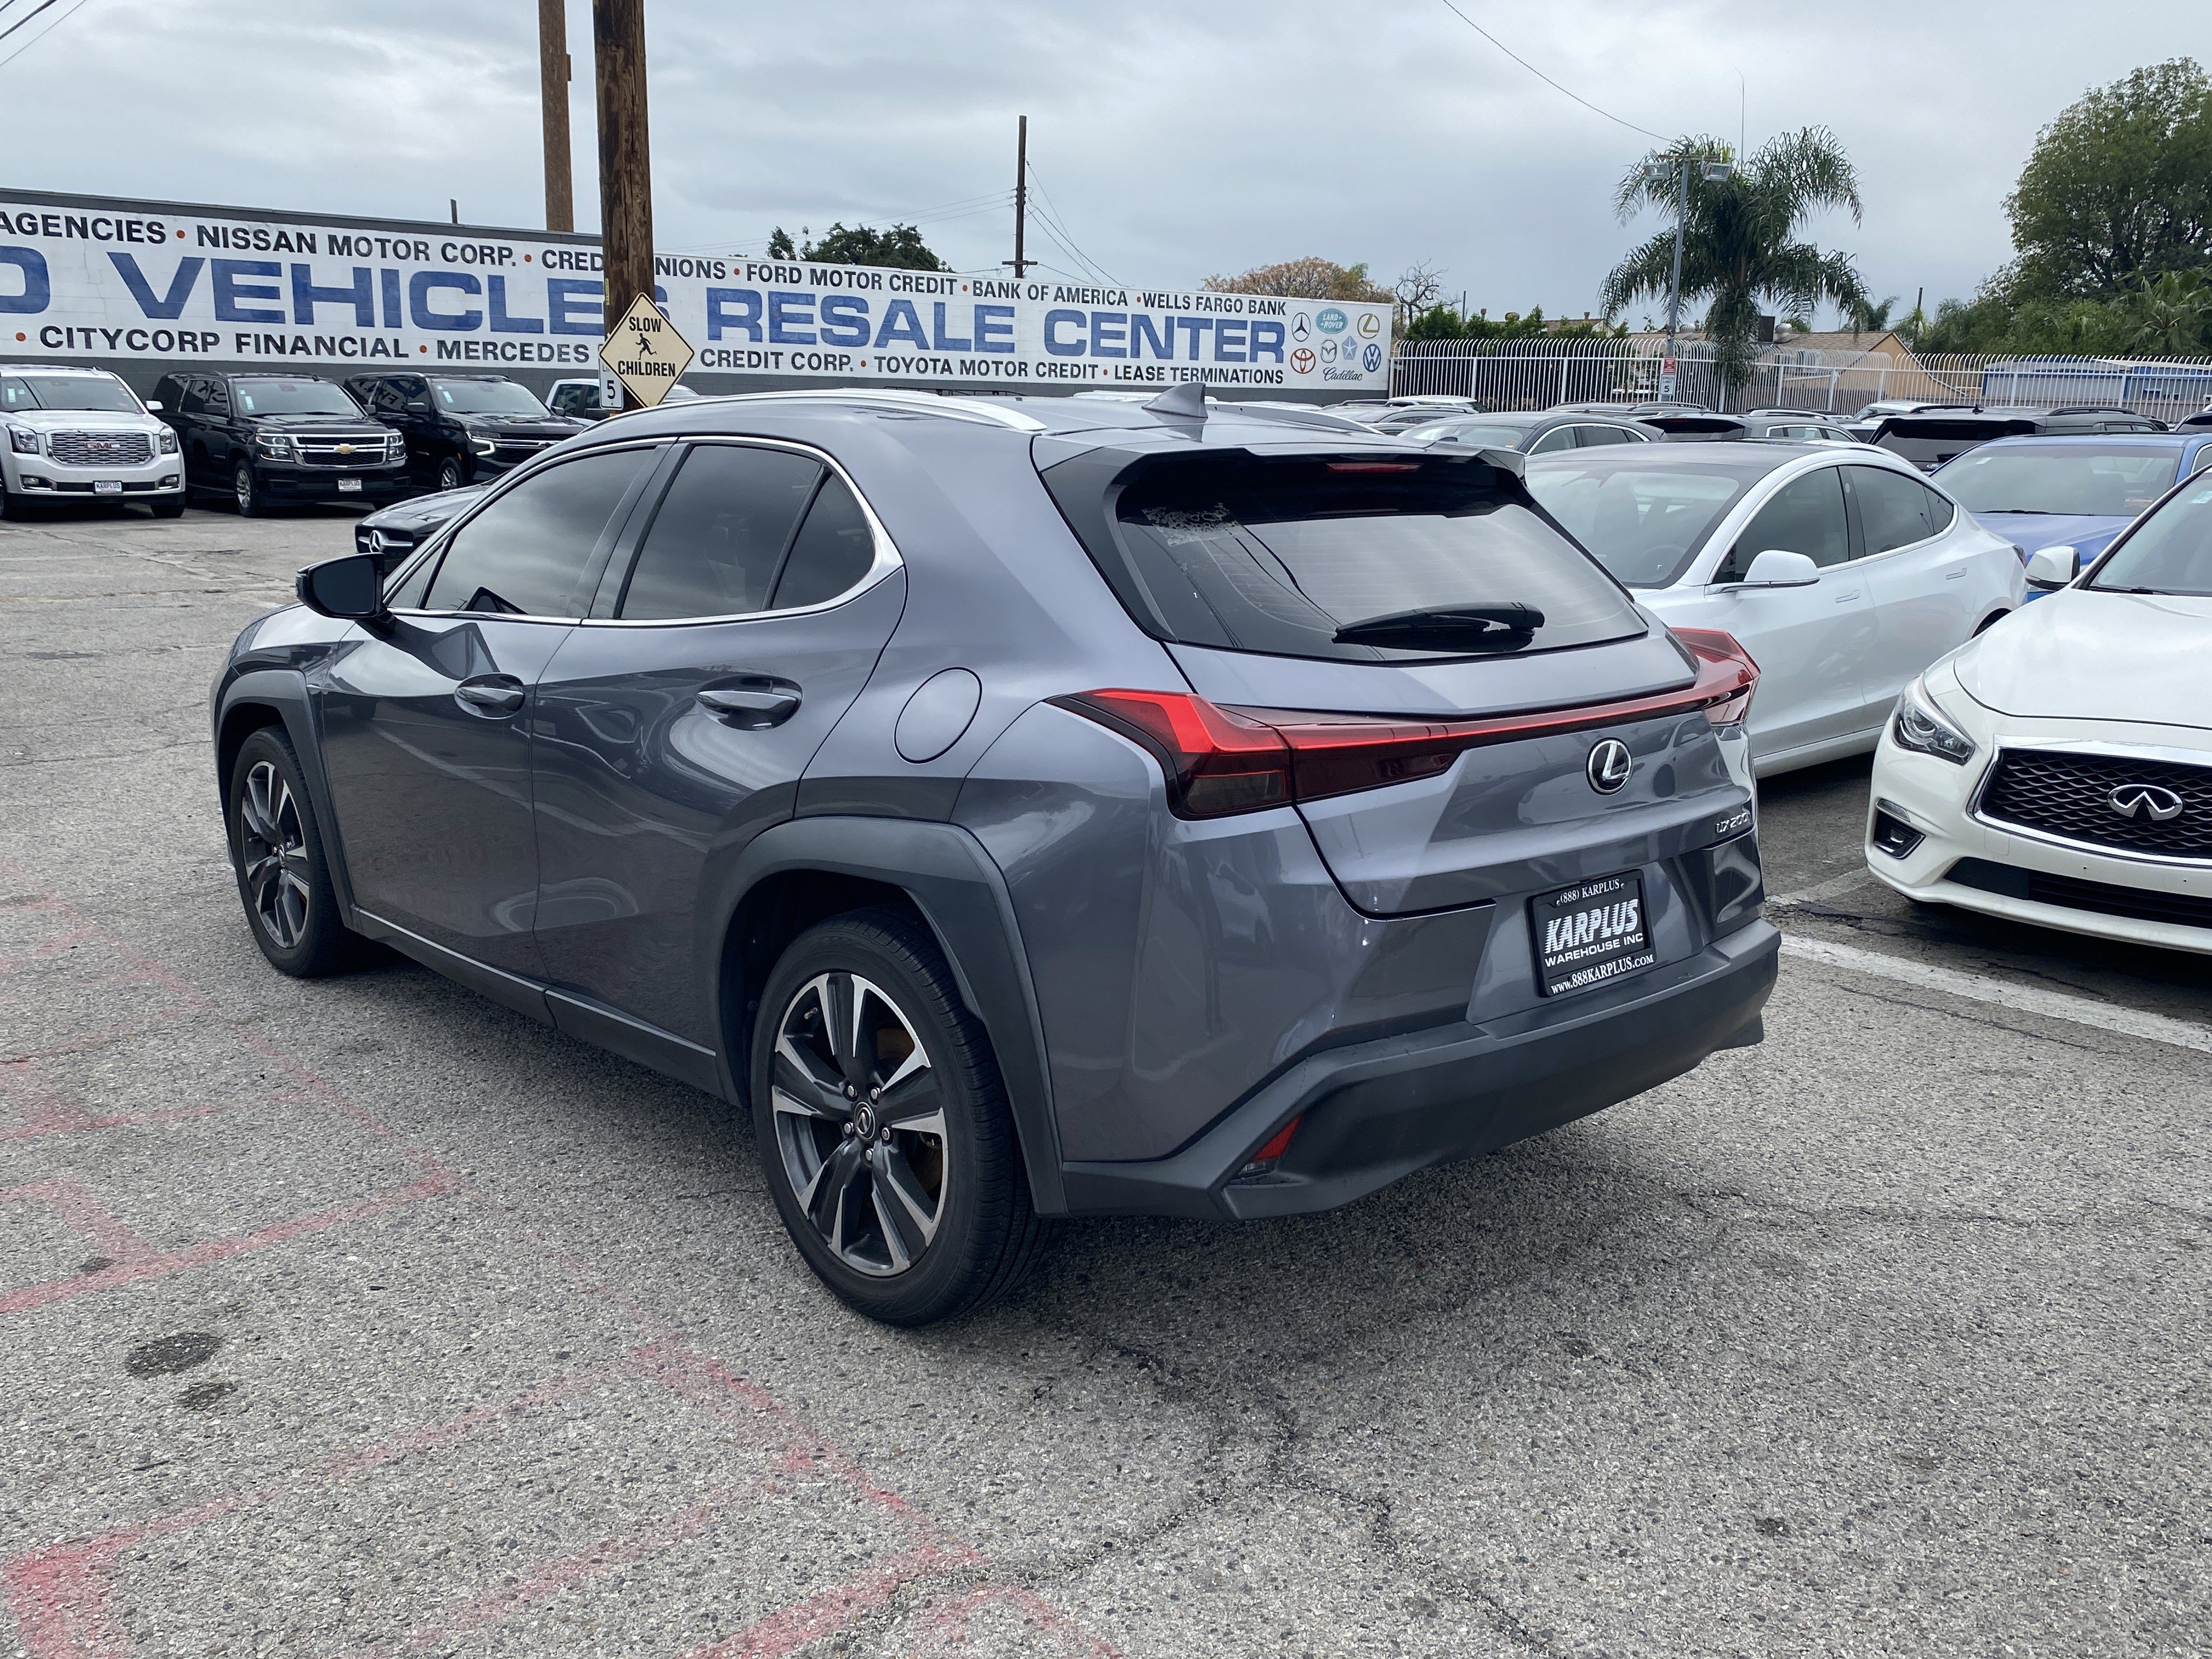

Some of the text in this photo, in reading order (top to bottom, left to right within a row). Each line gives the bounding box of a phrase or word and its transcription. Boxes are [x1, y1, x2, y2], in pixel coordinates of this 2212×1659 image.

[197, 225, 317, 254] NISSAN
[328, 234, 430, 262] MOTOR
[441, 242, 516, 267] CORP.
[541, 250, 603, 271] CRED
[655, 257, 726, 279] NIONS
[747, 263, 802, 284] FORD
[810, 268, 882, 290] MOTOR
[889, 275, 957, 296] CREDIT
[973, 280, 1021, 300] BANK
[1027, 284, 1049, 301] OF
[1053, 286, 1127, 306] AMERICA
[1143, 293, 1190, 310] WELLS
[1196, 296, 1243, 313] FARGO
[1249, 299, 1286, 316] BANK
[107, 251, 672, 336] VEHICLE
[706, 287, 1015, 353] RESALE
[1045, 308, 1285, 364] CENTER
[629, 316, 662, 332] SLOW
[40, 325, 1284, 384] CITYCORP FINANCIAL MERCEDES CREDIT CORP. TOYOTA MOTOR CREDIT LEASE TERMINATIONS
[618, 360, 676, 377] CHILDREN
[1323, 367, 1363, 381] Cadillac
[607, 380, 616, 399] 5
[1560, 878, 1620, 904] (888) KARPLUS
[1544, 898, 1639, 954] KARPLUS
[1545, 933, 1644, 967] WAREHOUSE INC
